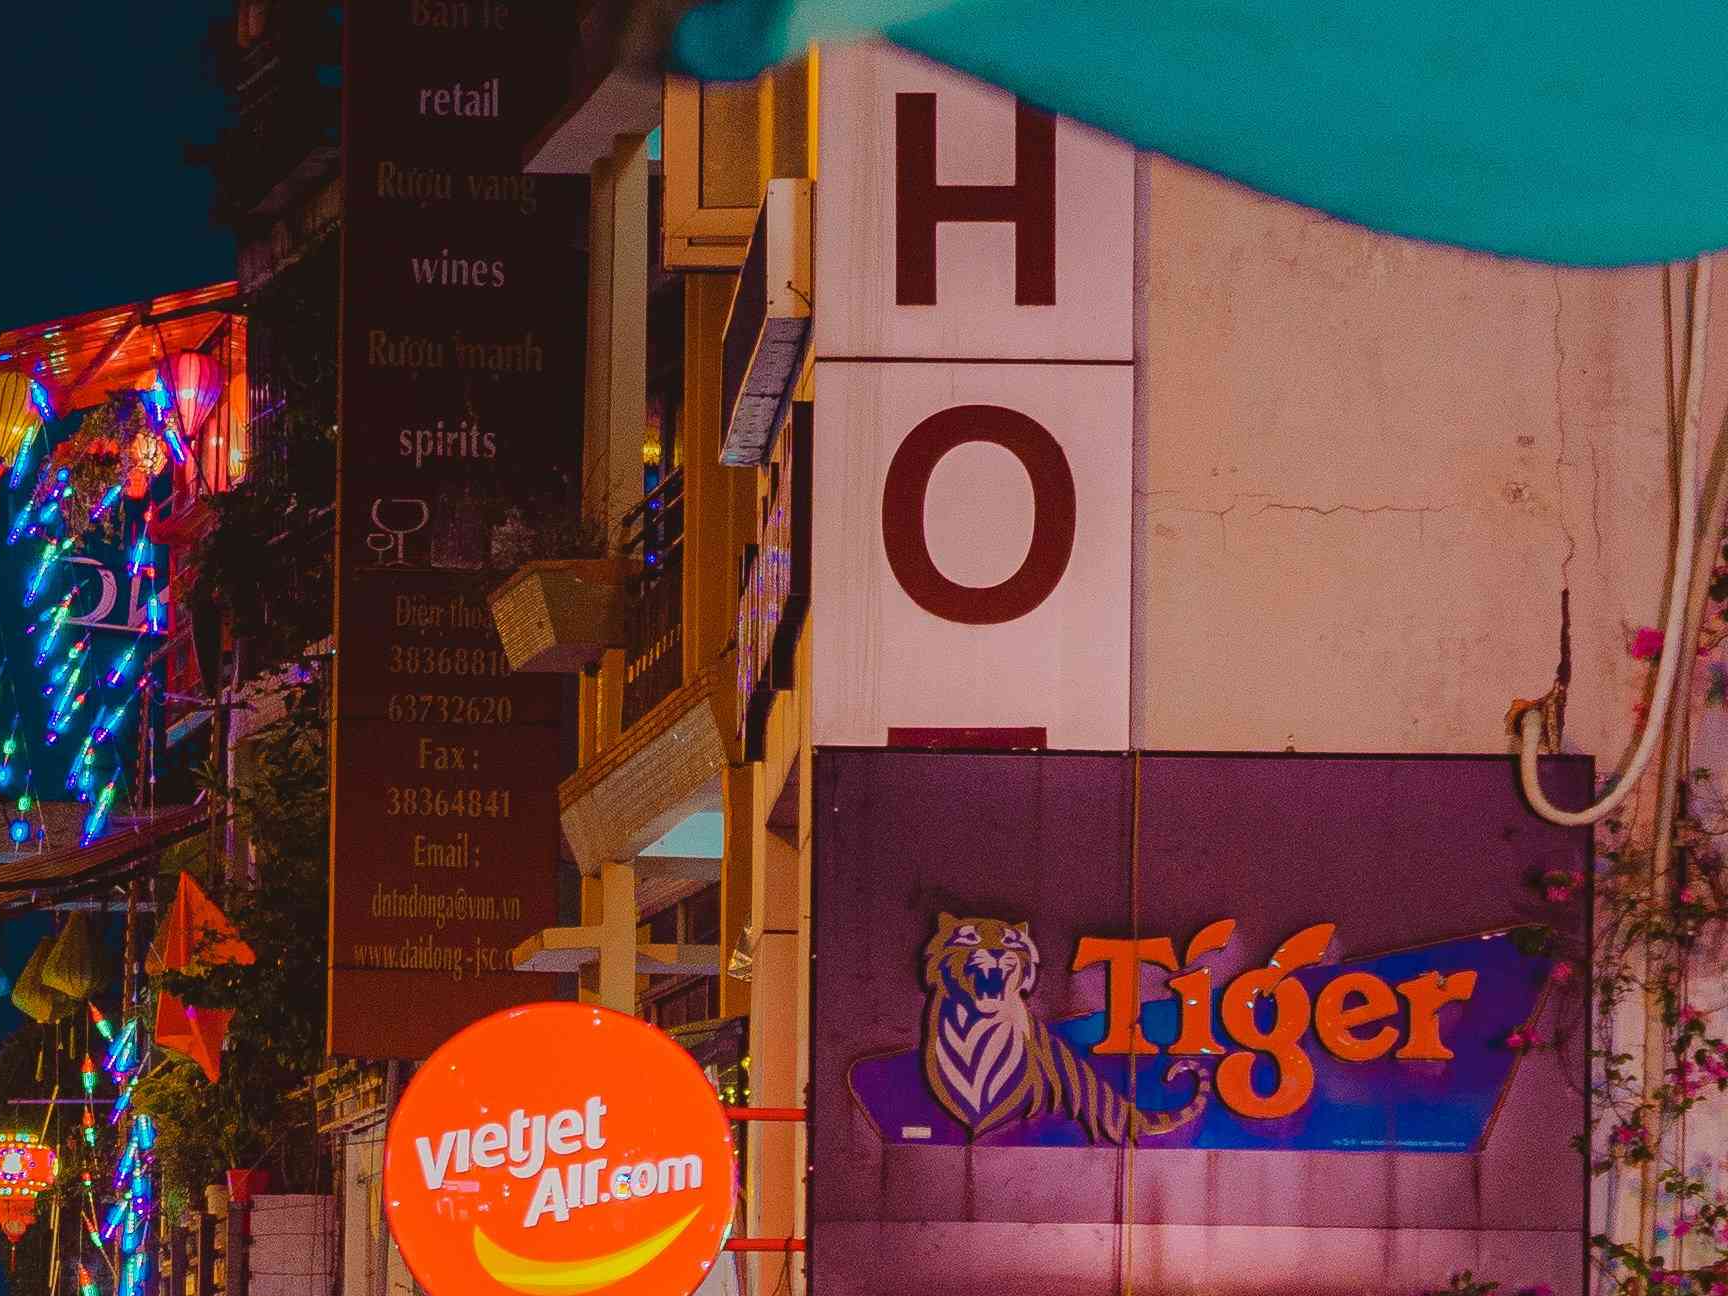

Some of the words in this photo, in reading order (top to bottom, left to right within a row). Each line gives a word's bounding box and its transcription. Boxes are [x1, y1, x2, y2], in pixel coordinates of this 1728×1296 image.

[419, 79, 500, 118] retail
[411, 249, 506, 288] wines
[882, 93, 1076, 749] HO
[398, 421, 497, 467] spirits
[418, 738, 465, 770] Fax
[386, 787, 511, 818] 38364841
[413, 833, 469, 868] Email
[1072, 917, 1479, 1118] Tiger
[414, 1095, 608, 1191] Vietjet
[522, 1153, 704, 1228] Air.com
